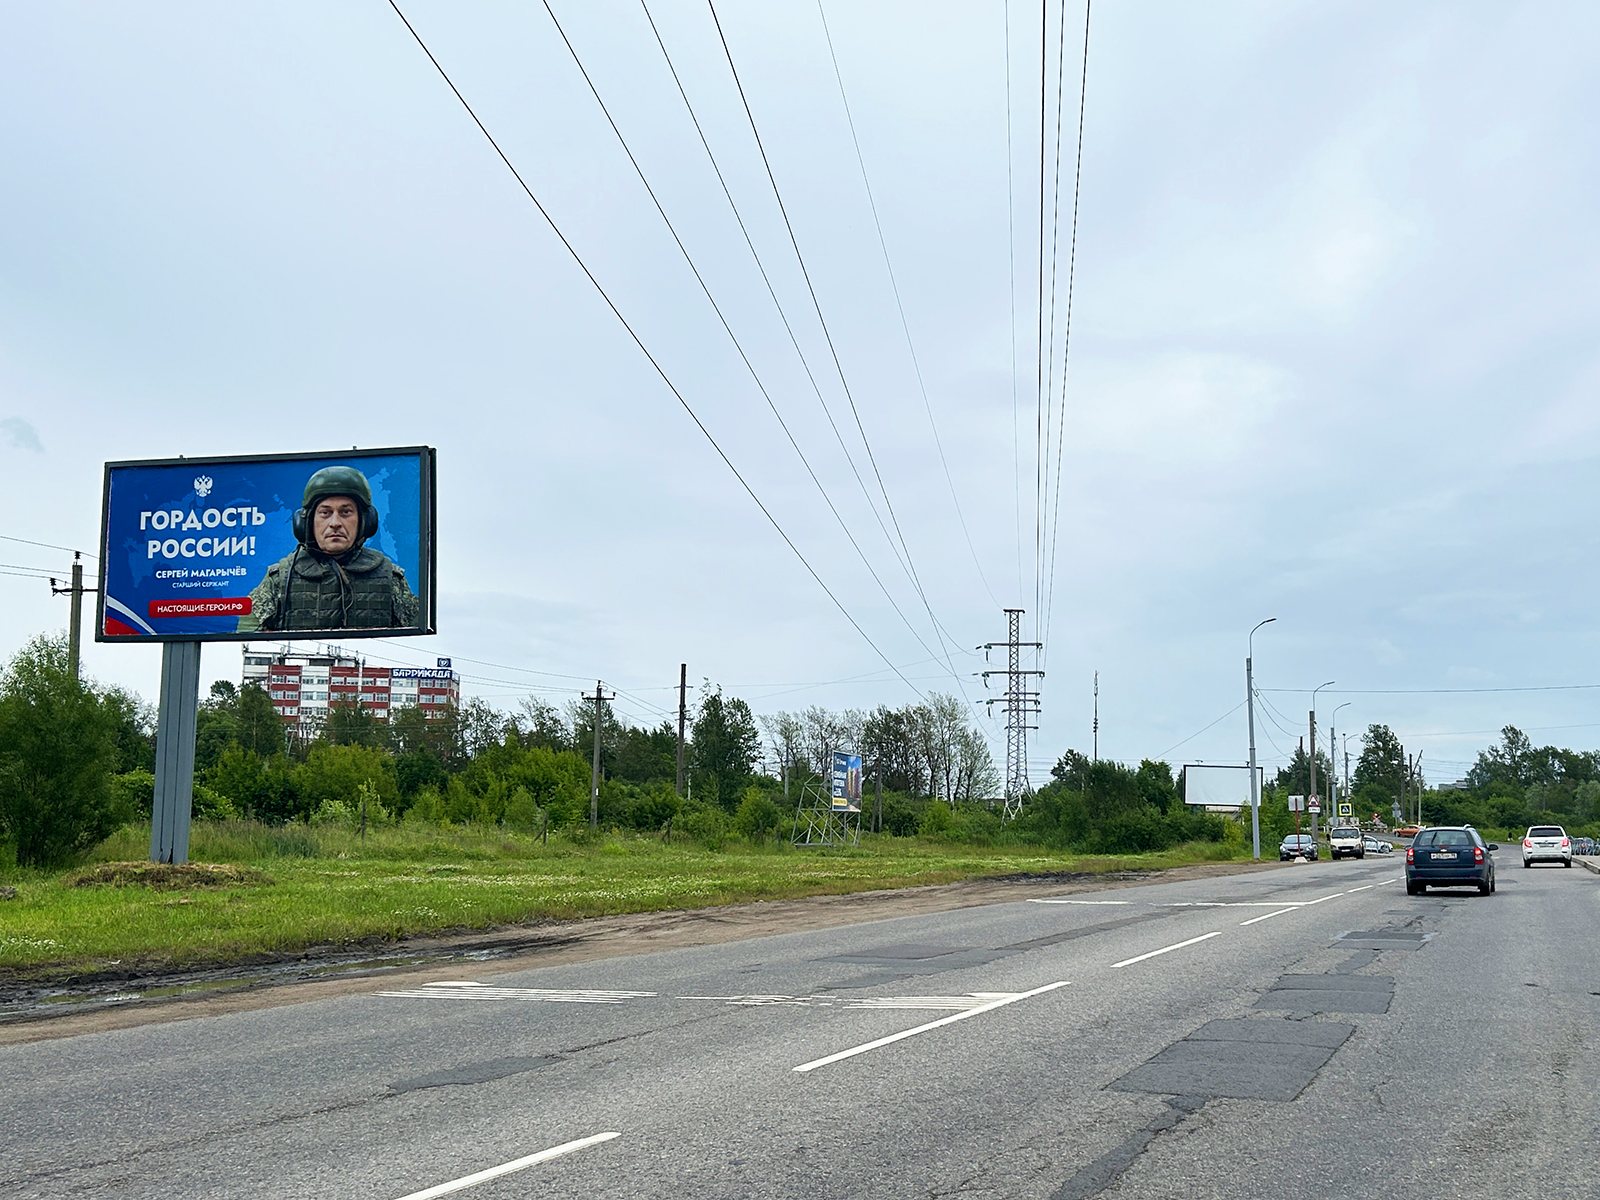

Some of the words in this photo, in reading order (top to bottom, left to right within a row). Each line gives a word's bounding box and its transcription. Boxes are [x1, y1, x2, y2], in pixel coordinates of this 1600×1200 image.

[140, 506, 266, 531] ГОРДОСТЬ
[147, 536, 256, 559] РОССИИ!
[155, 567, 189, 579] СЕРГЕЙ
[190, 565, 247, 578] МАГАРЫЧЁВ
[172, 580, 201, 589] СТАРШИЙ
[202, 580, 230, 588] СЕРЖАНТ
[157, 603, 243, 613] НАСТОЯЩИЕ-ГЕРОИ.РФ
[392, 668, 451, 678] БАРРИКАДА
